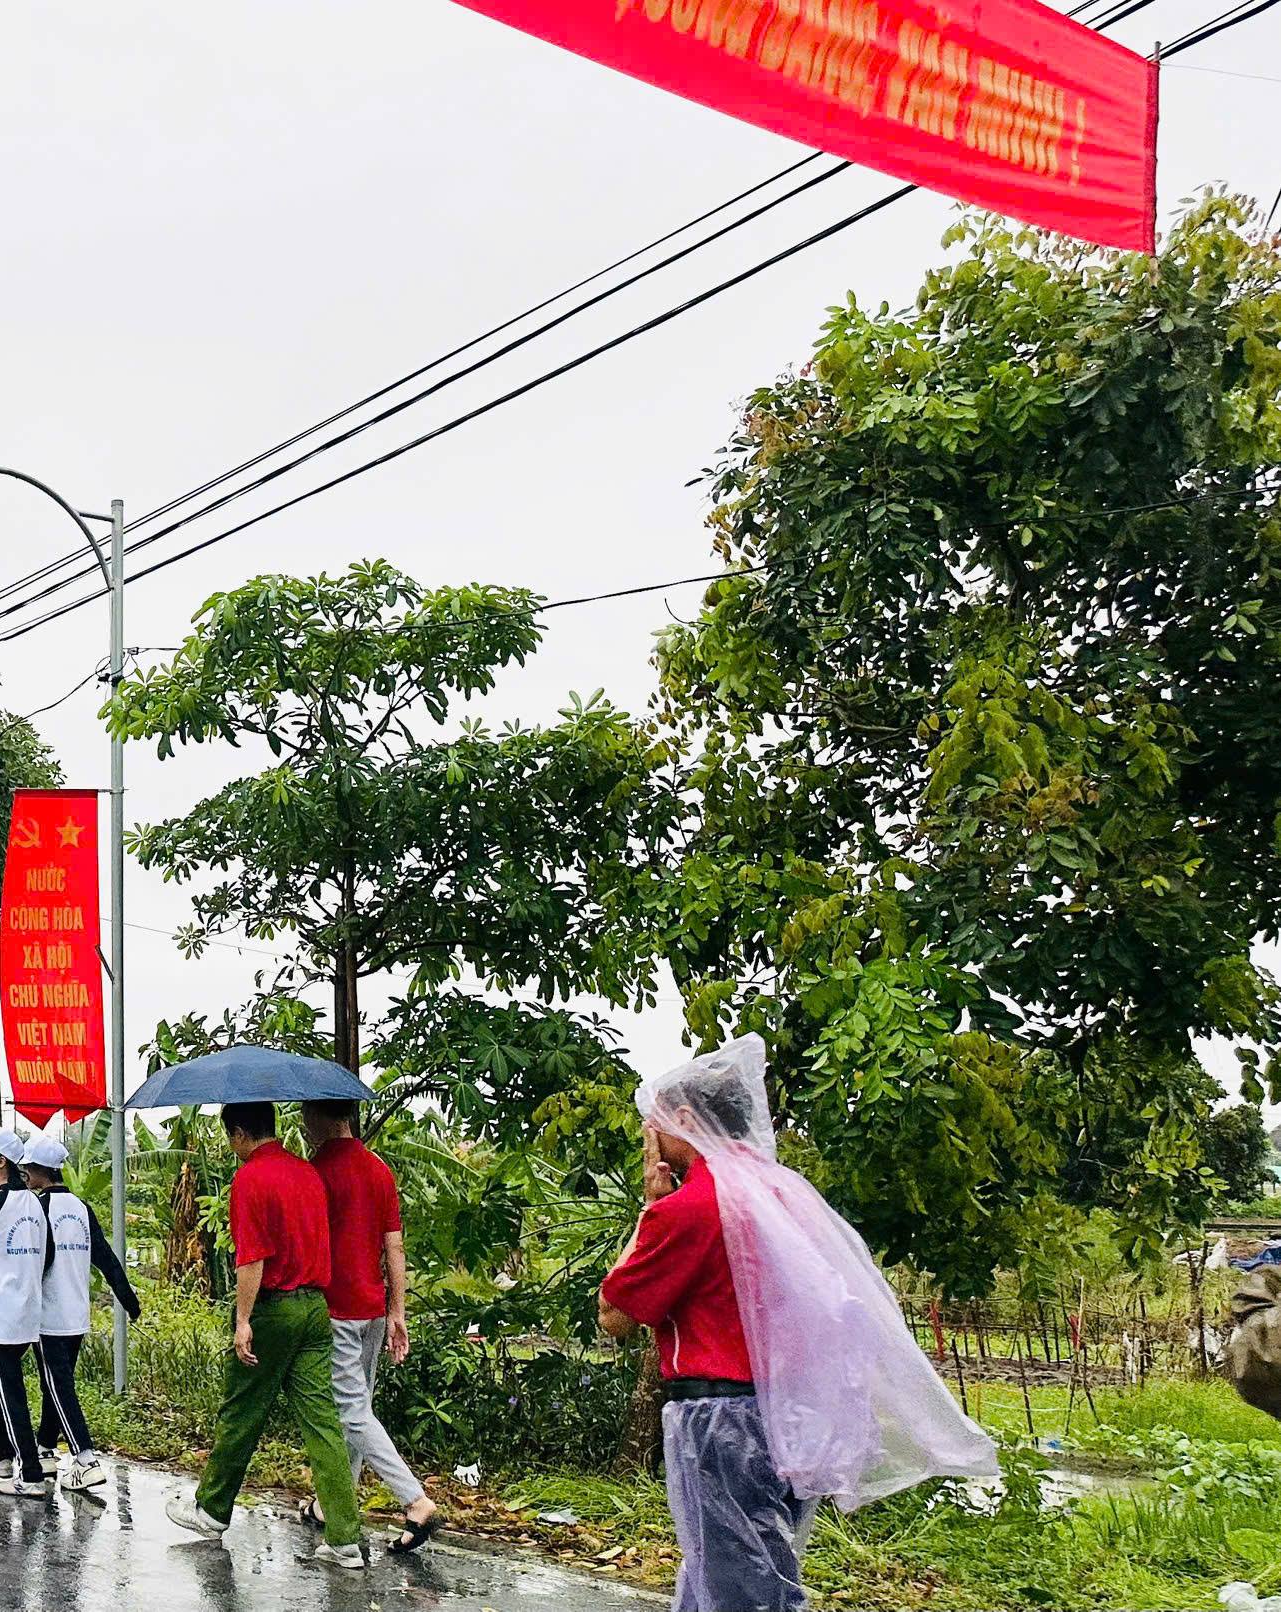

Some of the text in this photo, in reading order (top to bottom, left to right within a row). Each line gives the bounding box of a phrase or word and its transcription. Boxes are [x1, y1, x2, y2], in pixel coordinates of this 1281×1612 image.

[26, 861, 66, 891] NƯỚC
[10, 901, 84, 935] CỘNG HÒA
[23, 941, 71, 975] XÃ HỘI
[9, 975, 89, 1008] CHỦ NGHĨA
[17, 1018, 87, 1051] VIỆT NAM
[15, 1056, 55, 1084] MUÔN
